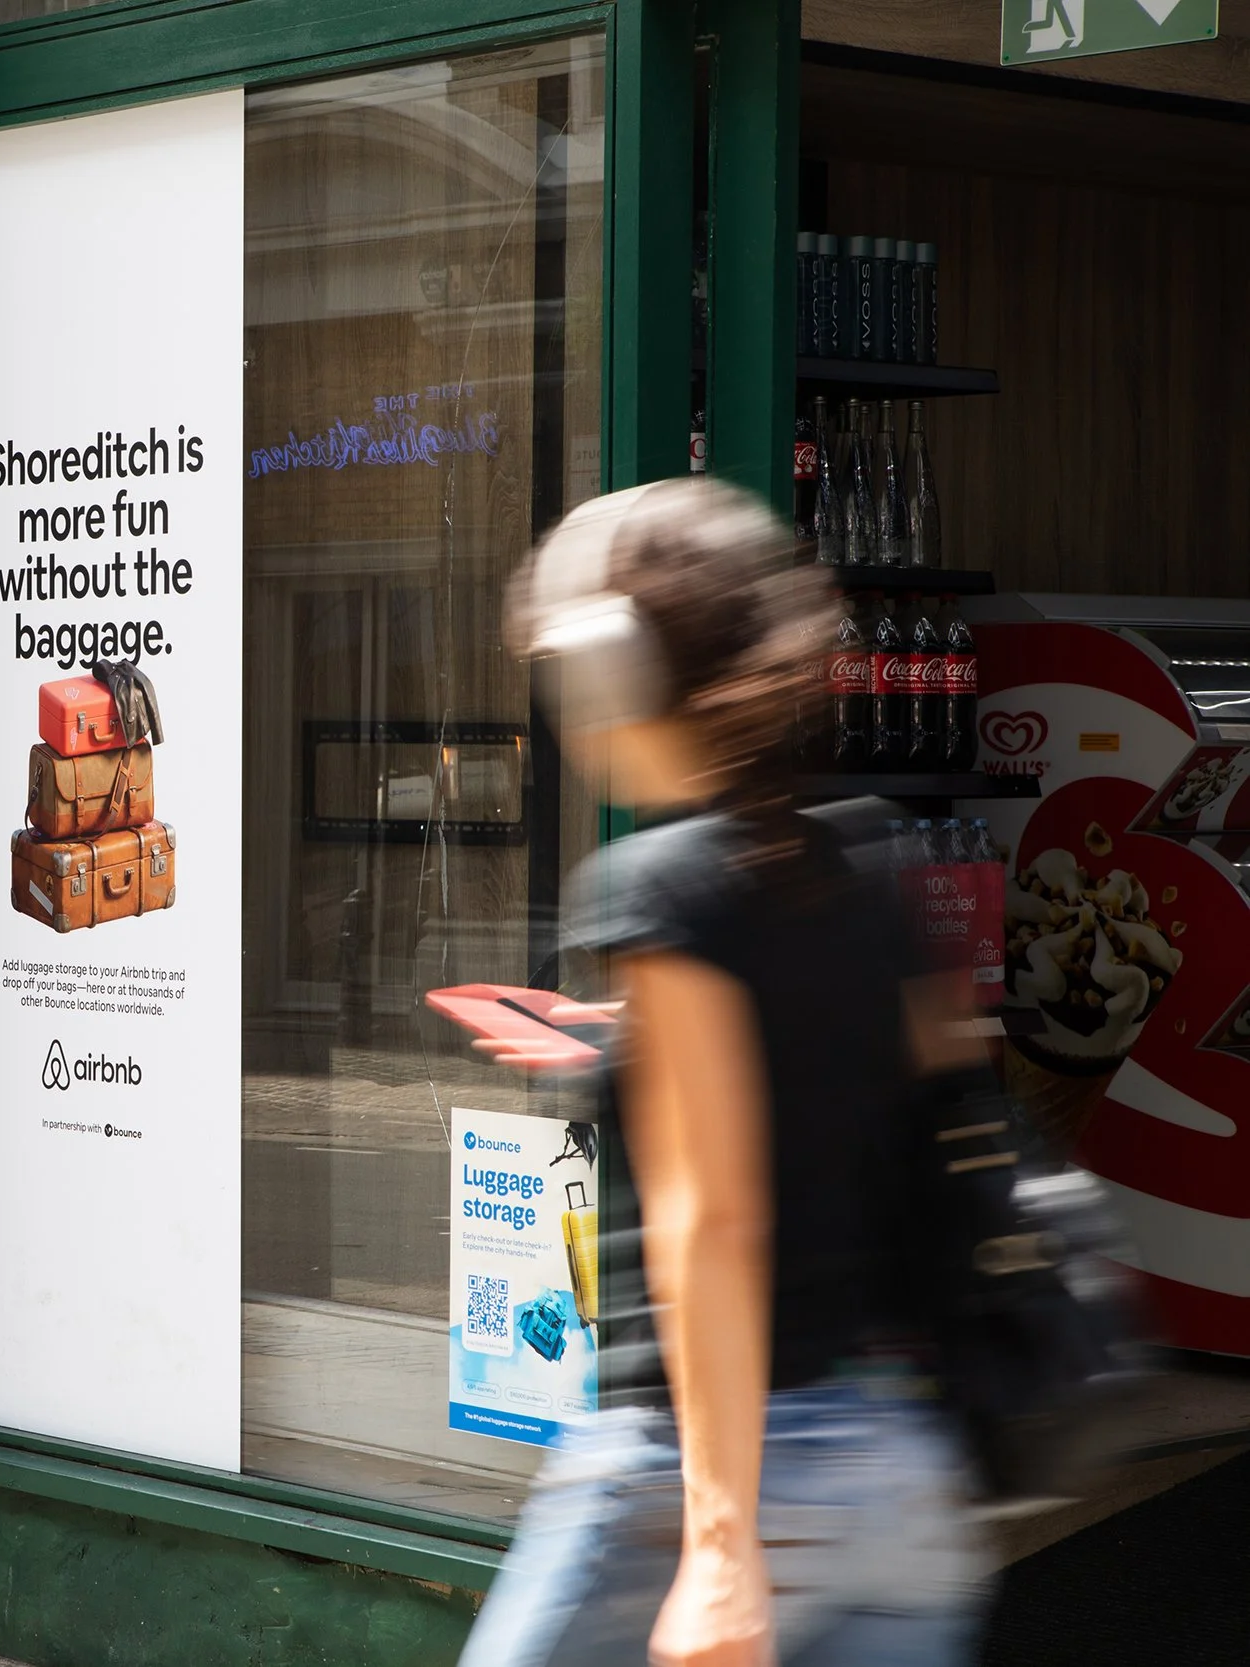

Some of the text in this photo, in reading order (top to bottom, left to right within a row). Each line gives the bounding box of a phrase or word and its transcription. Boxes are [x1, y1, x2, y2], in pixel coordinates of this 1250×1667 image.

[861, 263, 871, 339] VOSS
[177, 424, 204, 473] is
[18, 489, 169, 543] more fun
[133, 547, 193, 597] the
[15, 613, 173, 670] baggage.
[983, 760, 1044, 778] WALL'S
[924, 876, 958, 894] 100%
[926, 895, 977, 915] recycled
[973, 948, 1000, 964] evian
[2, 959, 186, 982] Add luggage storage to your Airbnb trip and
[2, 976, 22, 991] drop
[23, 977, 36, 990] off
[36, 980, 55, 993] your
[106, 984, 117, 994] or
[117, 984, 127, 996] at
[128, 984, 174, 999] thousands
[175, 987, 185, 999] of
[20, 995, 165, 1016] other Bounce locations worldwide.
[73, 1052, 142, 1086] airbnb
[42, 1118, 142, 1139] In partnership with bounce
[477, 1135, 521, 1154] bounce
[463, 1163, 544, 1200] Luggage
[463, 1197, 536, 1231] storage
[462, 1231, 476, 1241] Early
[477, 1233, 505, 1245] check-out
[513, 1239, 523, 1247] late
[462, 1241, 484, 1251] Explore
[484, 1245, 494, 1253] the
[495, 1246, 505, 1255] city
[478, 1414, 492, 1423] global
[492, 1417, 508, 1427] luggage
[508, 1421, 524, 1430] storage
[524, 1424, 542, 1432] network
